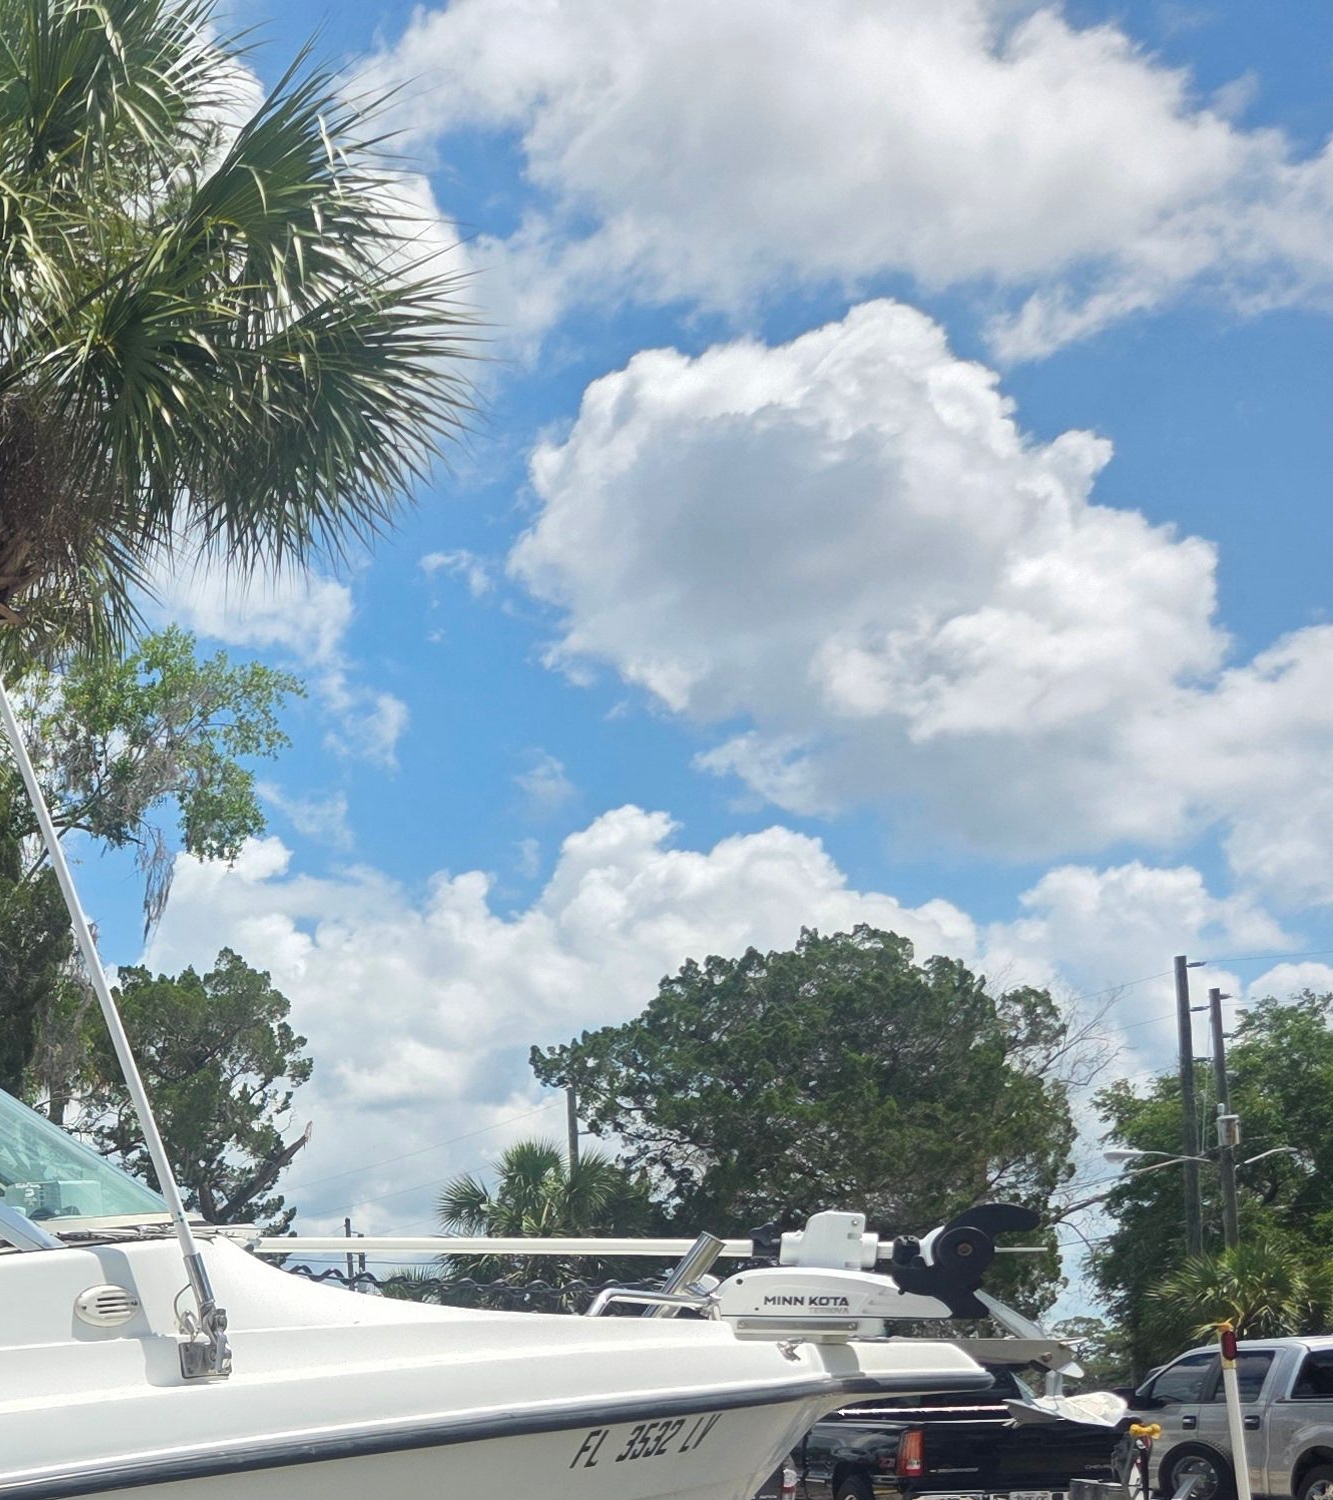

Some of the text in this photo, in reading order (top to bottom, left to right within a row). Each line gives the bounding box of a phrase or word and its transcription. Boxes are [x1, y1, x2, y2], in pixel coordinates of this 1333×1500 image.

[764, 1296, 849, 1306] MINN KOTA
[569, 1429, 610, 1469] FL
[615, 1418, 686, 1462] 3532
